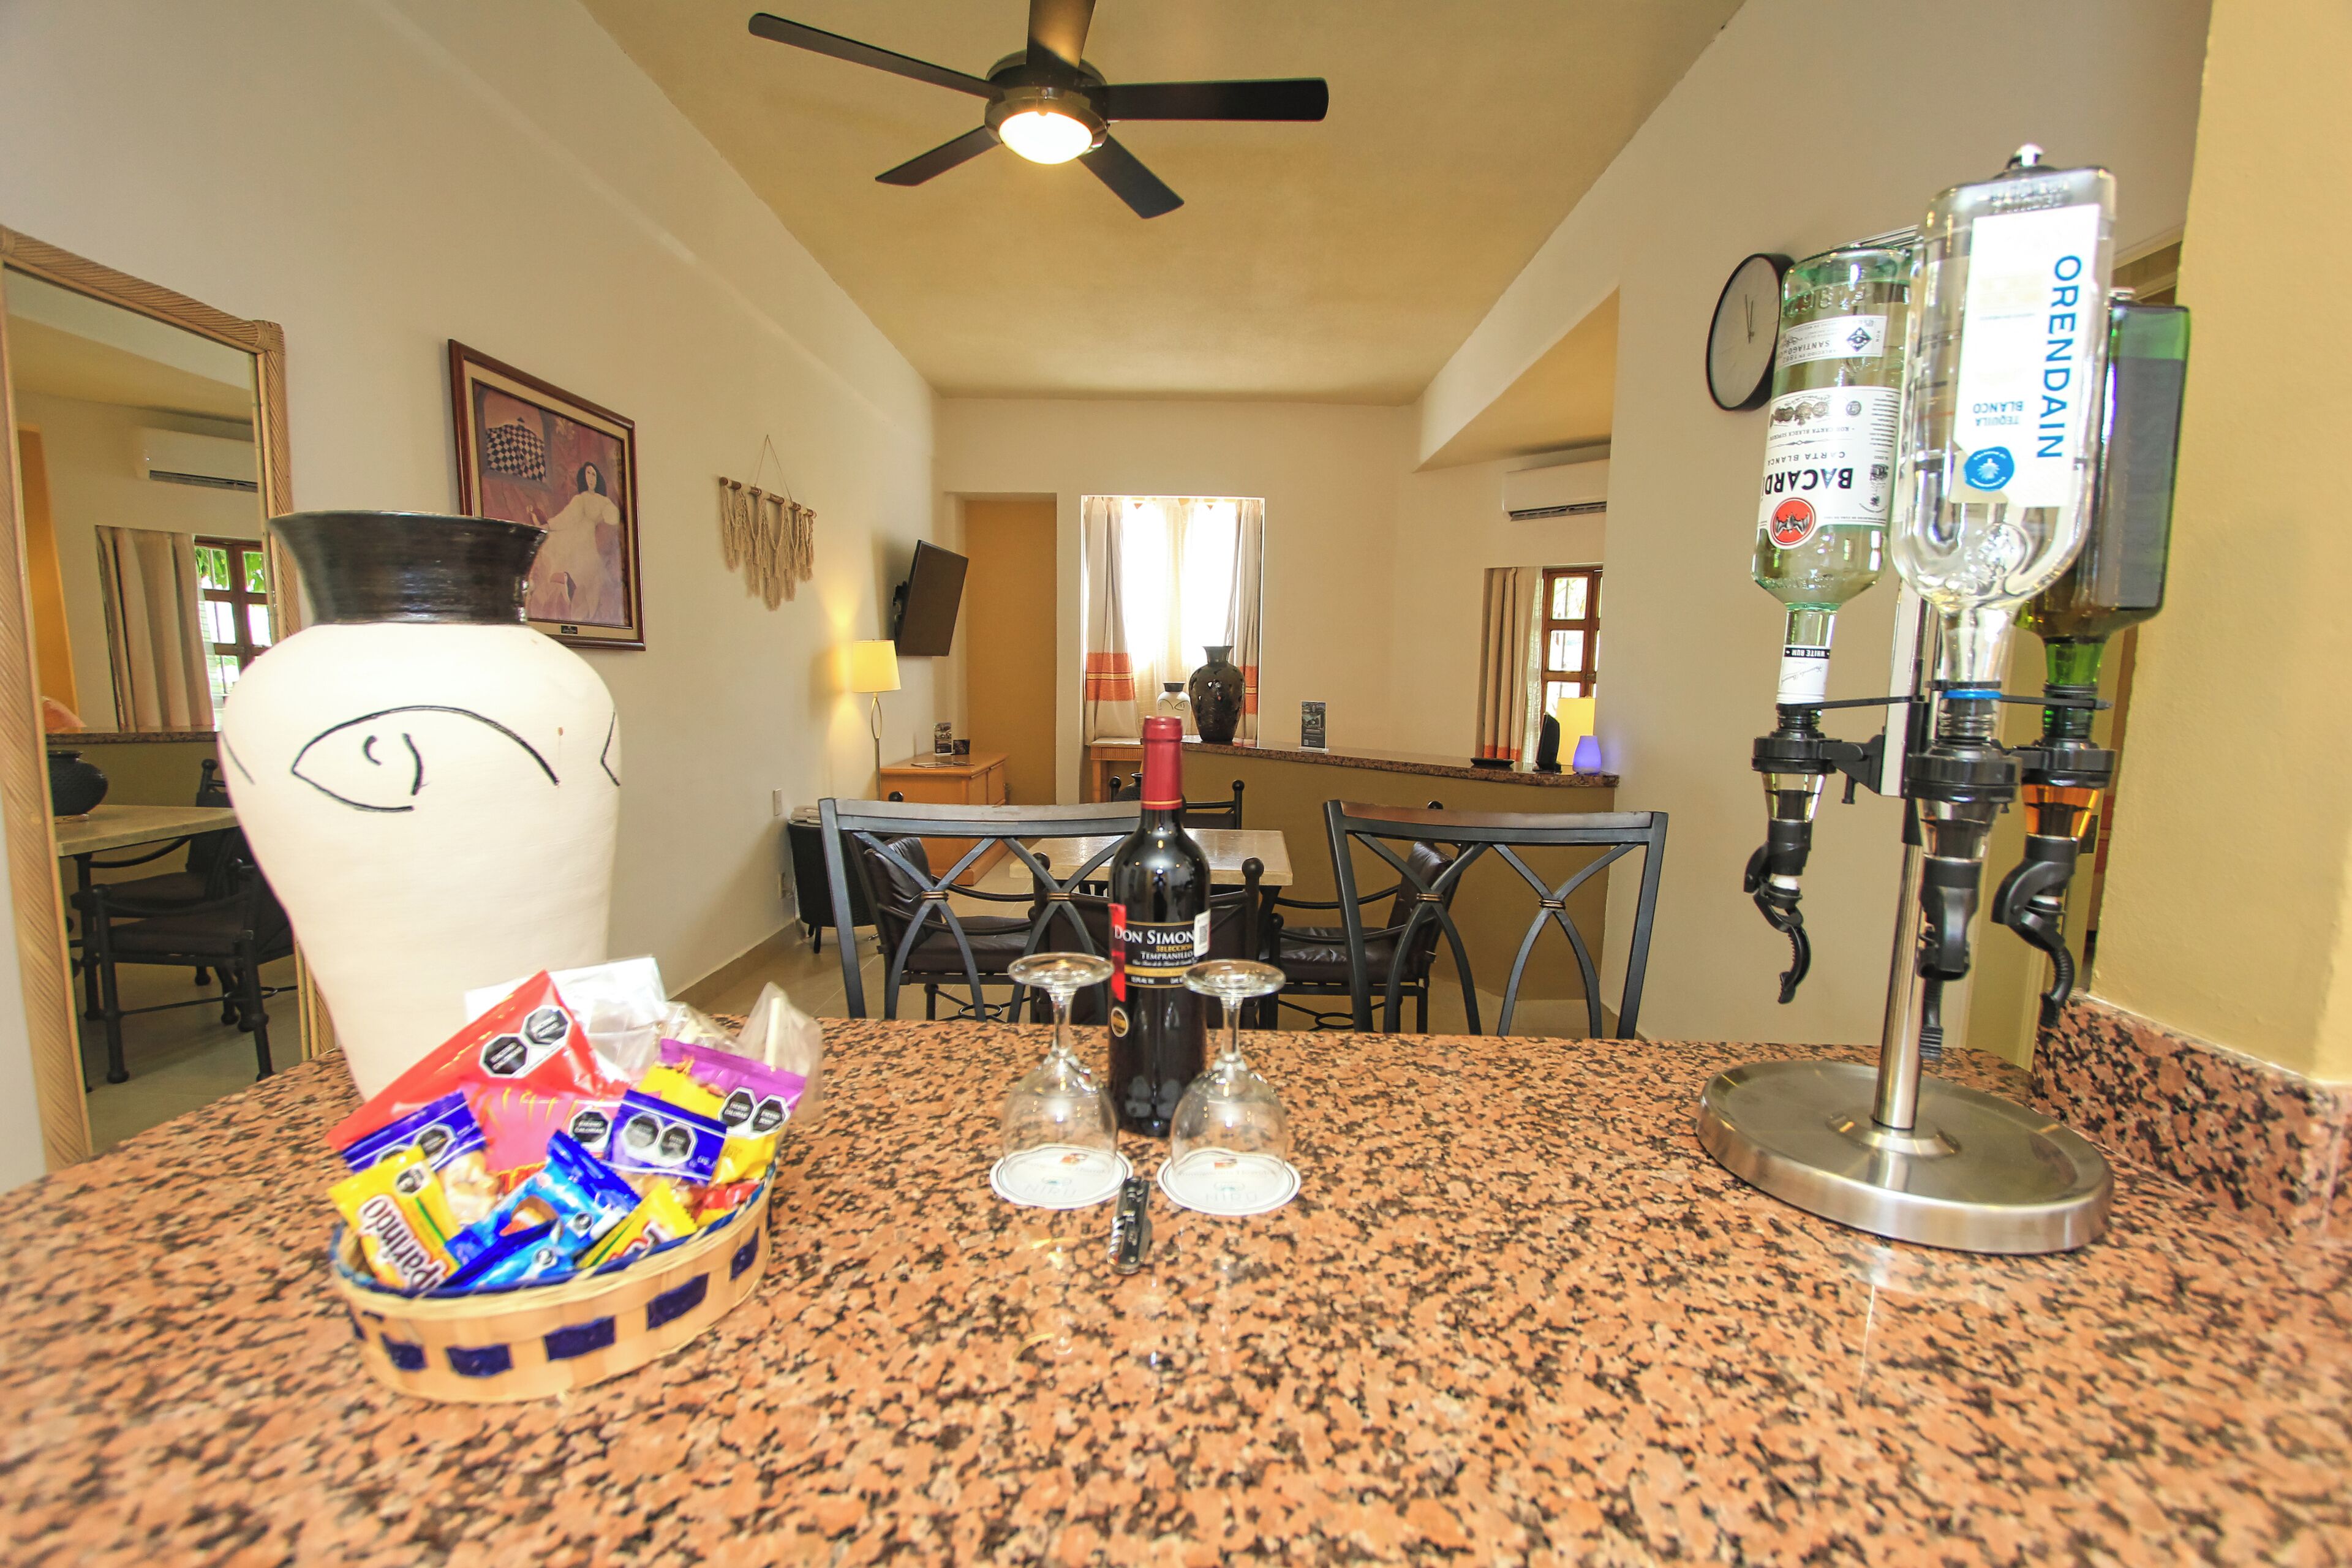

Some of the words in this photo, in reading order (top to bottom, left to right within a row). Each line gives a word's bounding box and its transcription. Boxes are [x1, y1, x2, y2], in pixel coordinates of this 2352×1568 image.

[1789, 340, 1830, 355] SANTIAGO
[2036, 255, 2082, 458] ORENDAIN
[1972, 401, 2024, 414] BLANCO
[1975, 415, 2019, 426] TEQUILA
[1768, 454, 1800, 466] BLANCA
[1804, 451, 1845, 461] CARTA
[1115, 925, 1143, 944] DON
[1140, 951, 1194, 960] TEMPRANILLO
